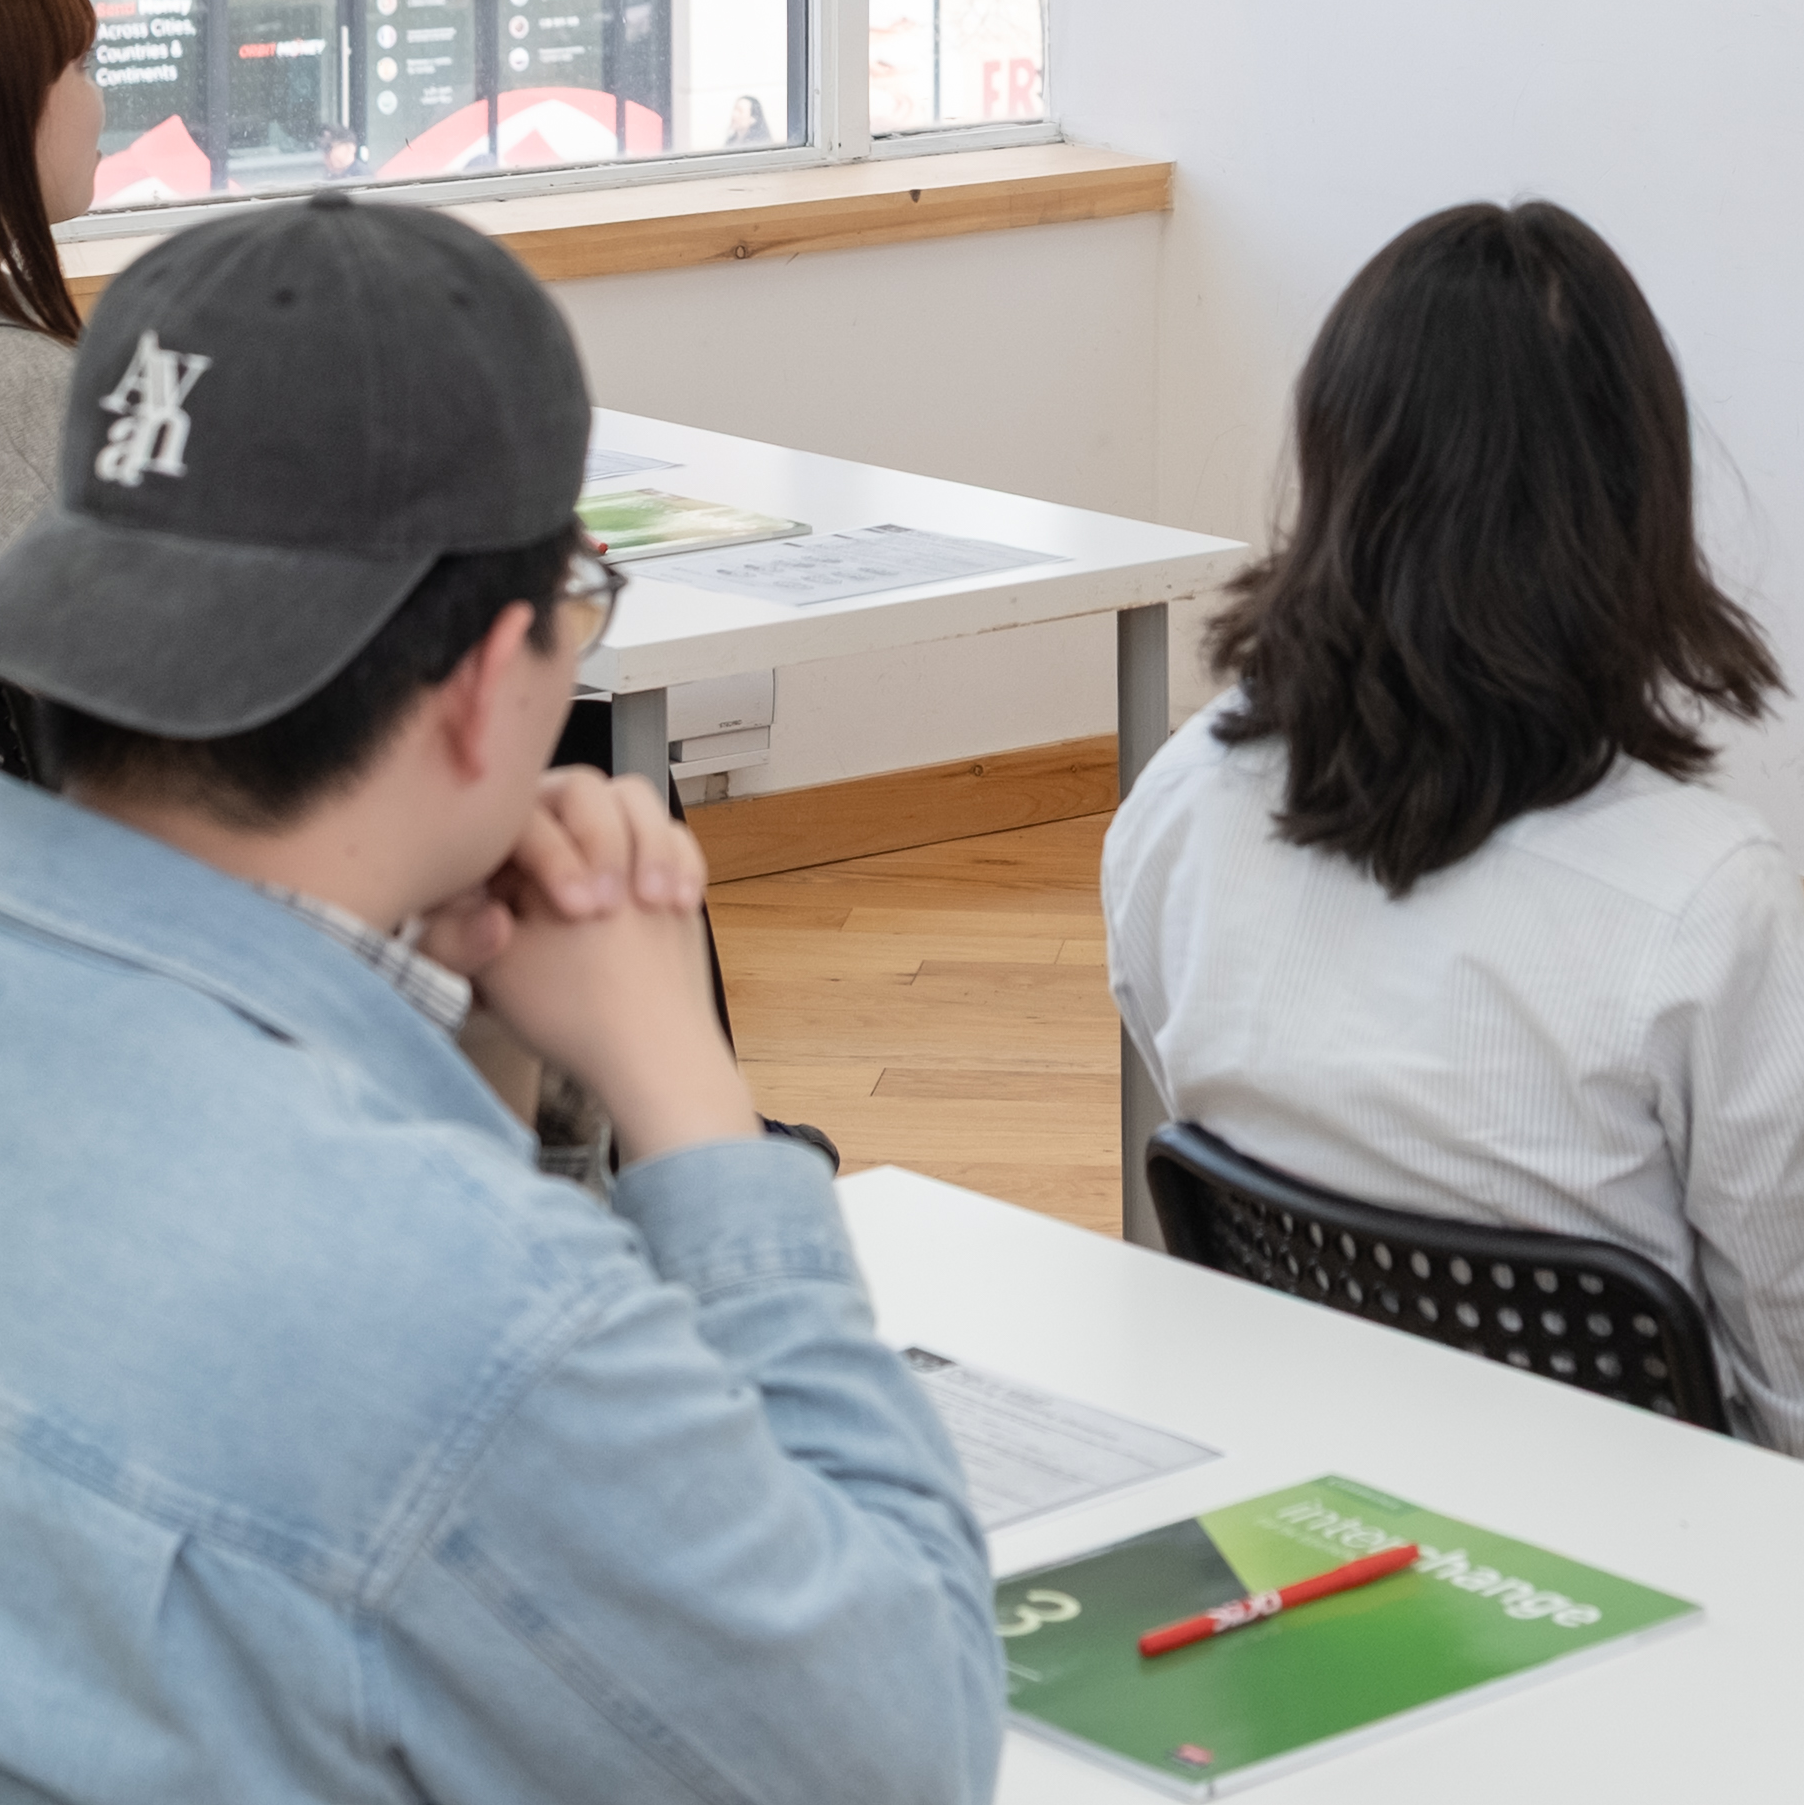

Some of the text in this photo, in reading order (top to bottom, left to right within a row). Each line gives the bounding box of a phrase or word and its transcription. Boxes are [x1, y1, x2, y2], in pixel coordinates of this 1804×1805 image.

[96, 21, 149, 41] Across
[96, 42, 169, 64] Countries
[95, 65, 178, 87] Continents
